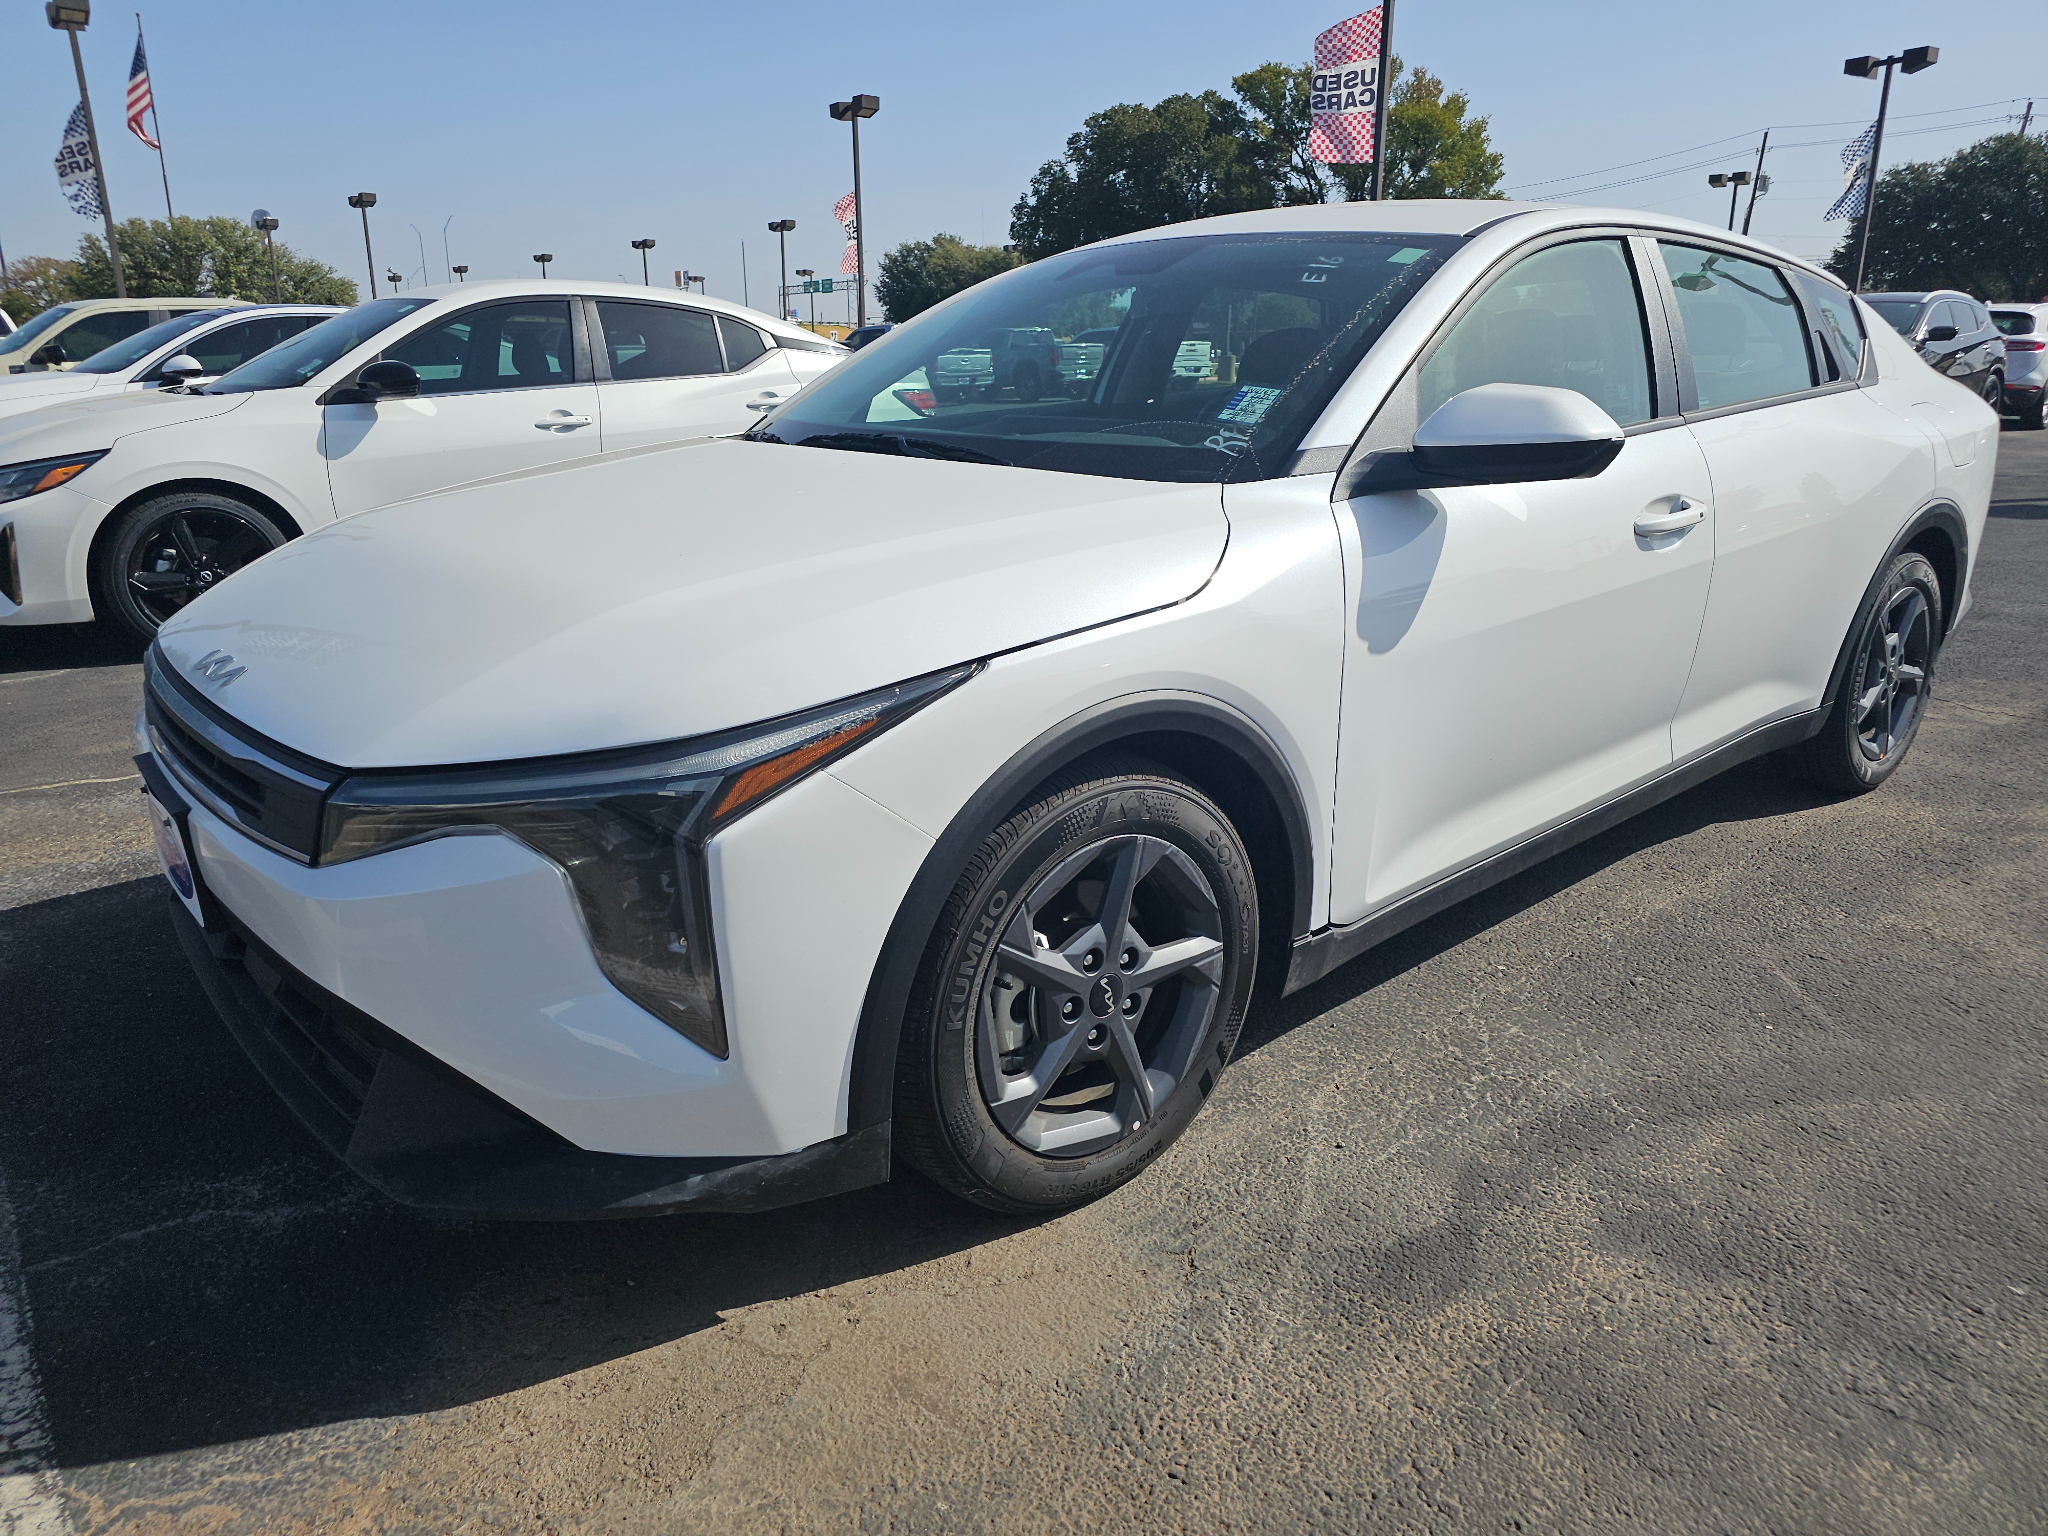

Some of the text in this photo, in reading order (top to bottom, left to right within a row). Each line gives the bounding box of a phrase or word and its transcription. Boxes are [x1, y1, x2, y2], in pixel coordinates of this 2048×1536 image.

[1205, 829, 1251, 922] SOLUS
[946, 890, 1008, 1031] KUMHO
[1114, 1139, 1163, 1179] 205/55
